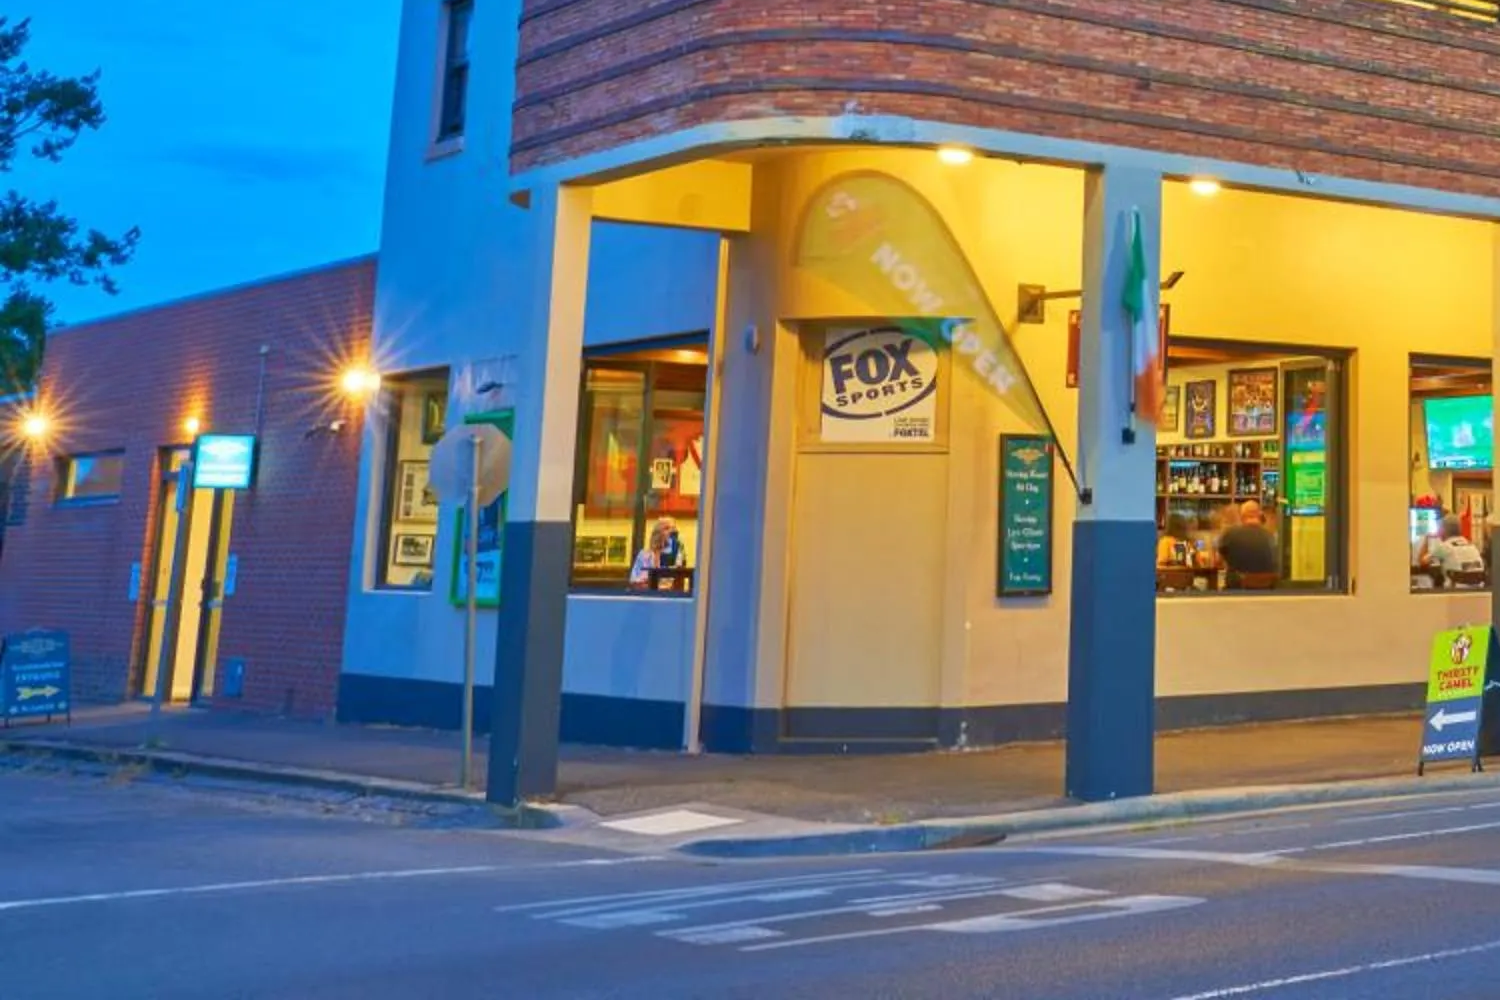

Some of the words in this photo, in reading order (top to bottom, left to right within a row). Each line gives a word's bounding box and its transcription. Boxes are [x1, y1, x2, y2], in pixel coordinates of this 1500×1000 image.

[870, 242, 942, 313] NOW
[829, 338, 920, 395] FOX
[835, 377, 924, 407] SPORTS
[1437, 665, 1479, 681] THIRSTY
[1439, 677, 1474, 691] CAMEL
[1423, 743, 1444, 754] NOW
[1447, 738, 1475, 753] OPEN
